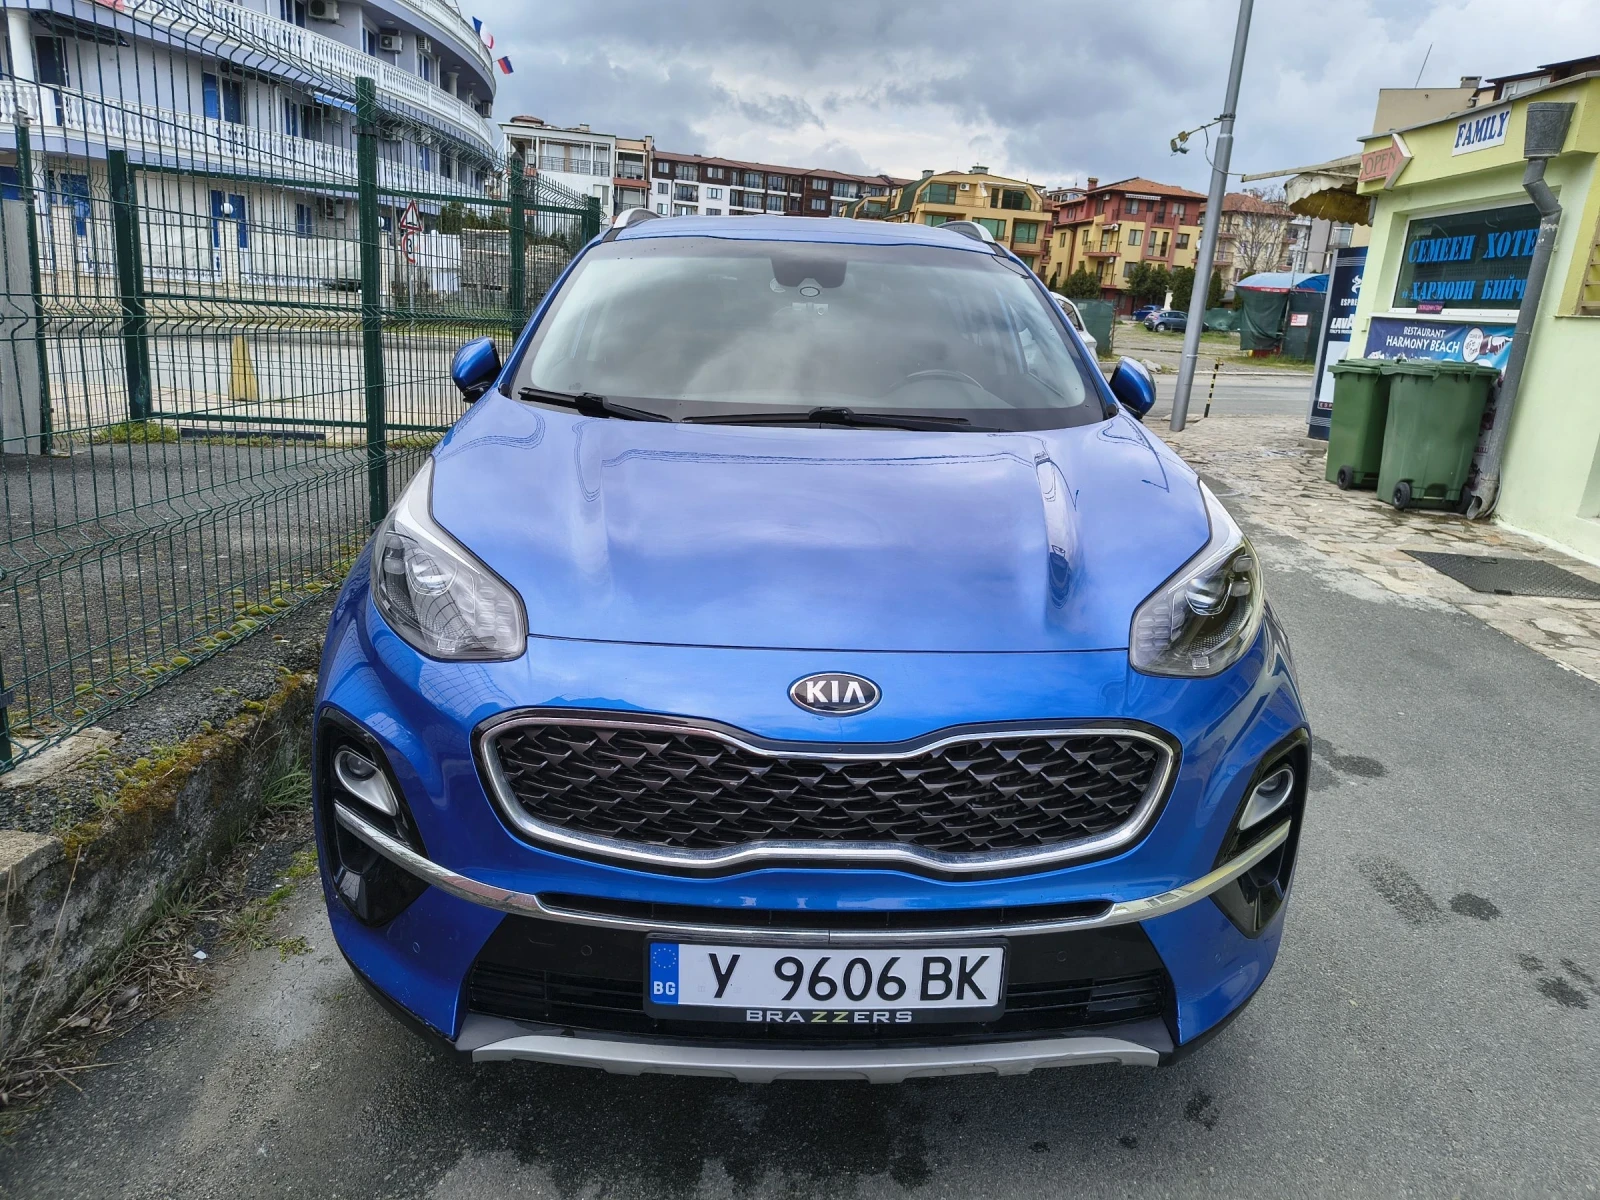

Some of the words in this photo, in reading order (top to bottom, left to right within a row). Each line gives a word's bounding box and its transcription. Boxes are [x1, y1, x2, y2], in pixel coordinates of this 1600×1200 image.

[1454, 110, 1510, 148] FAMILY
[1364, 151, 1397, 176] OPEN
[1408, 235, 1476, 263] СЕМЕЕН
[1482, 228, 1540, 259] ХОТЕ
[1340, 298, 1358, 306] ESPRE
[1330, 313, 1355, 329] LAVA
[1403, 326, 1446, 339] RESTAURANT
[1386, 335, 1429, 351] HARMONY
[1430, 340, 1460, 353] BEACH
[805, 680, 866, 703] KIA
[774, 956, 907, 1001] 9606
[653, 981, 676, 996] BG
[745, 1009, 913, 1023] BRAZZERS
